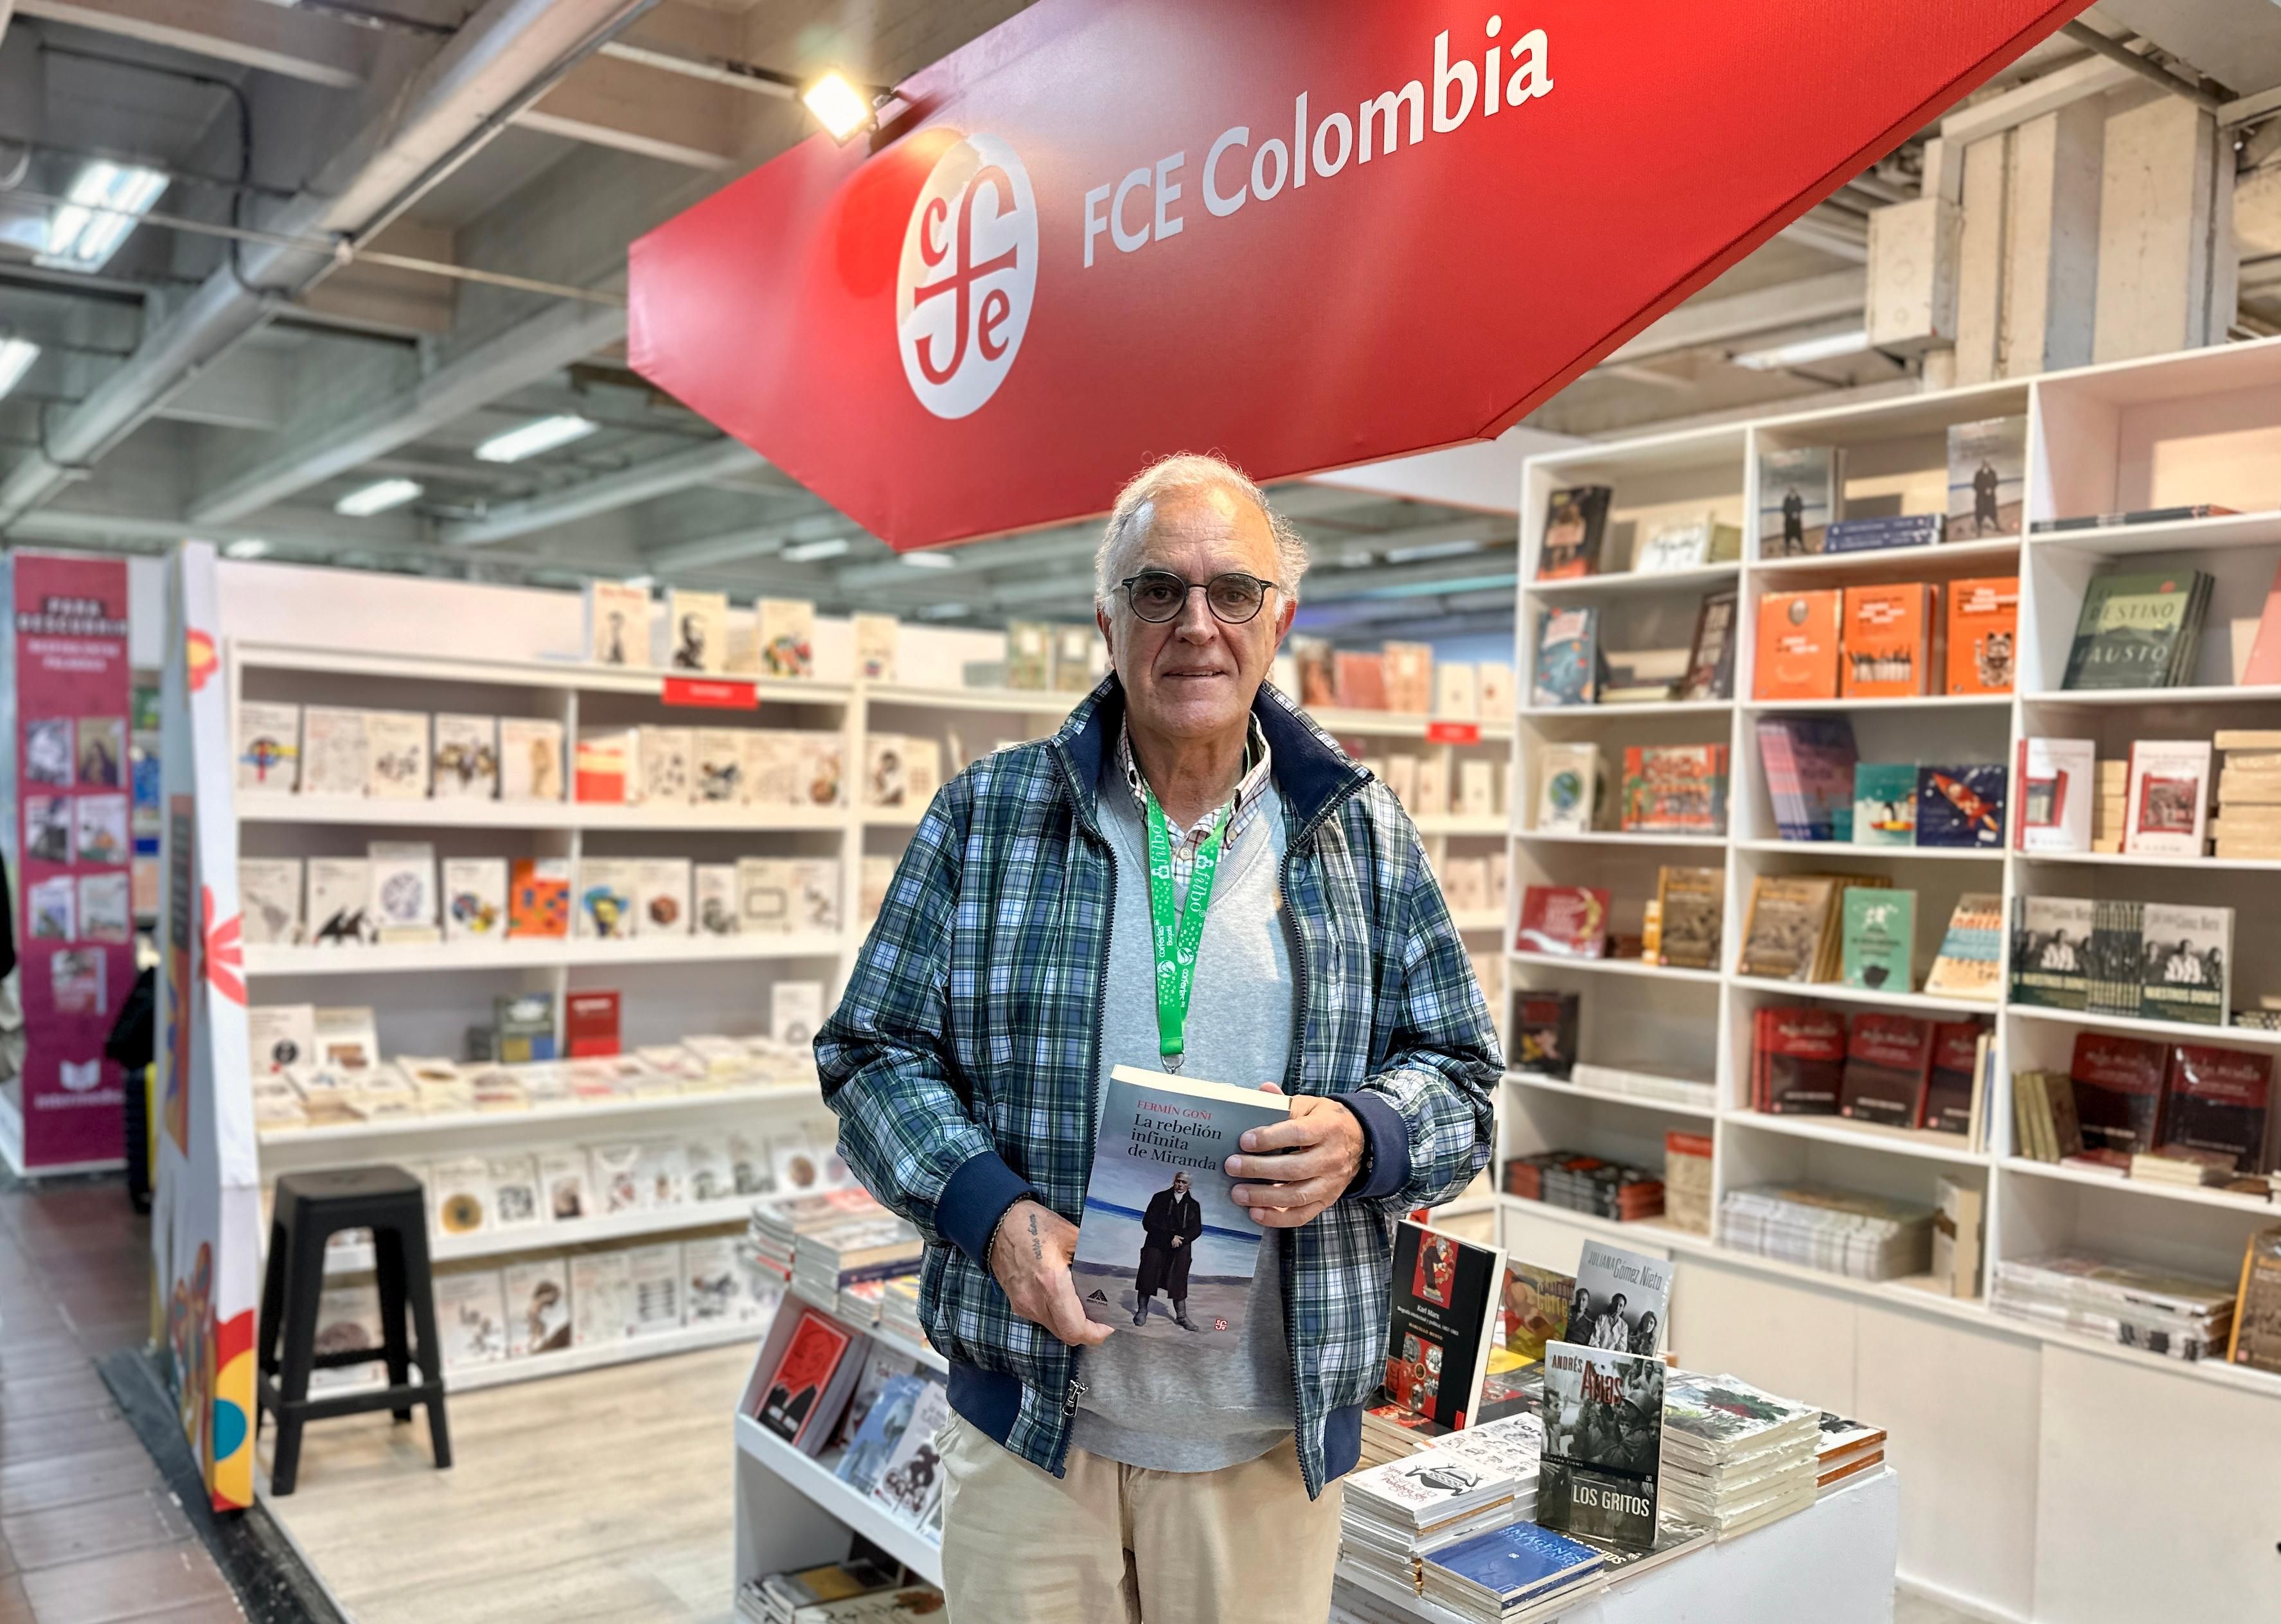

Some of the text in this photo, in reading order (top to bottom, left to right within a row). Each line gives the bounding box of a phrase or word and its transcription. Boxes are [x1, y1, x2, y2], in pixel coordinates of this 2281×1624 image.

[1083, 14, 1554, 268] FCE Colombia
[1151, 825, 1168, 864] filbo
[1190, 869, 1211, 912] filbo
[1137, 1100, 1212, 1120] FERMÍN GOÑI
[1131, 1128, 1189, 1151] infinita
[1134, 1113, 1221, 1140] La rebelión
[1128, 1143, 1217, 1170] de Miranda
[1588, 1251, 1662, 1291] JULIANA Gómez Nieto
[1417, 1305, 1440, 1320] Karl Marx
[1552, 1354, 1624, 1406] ANDRÉS Arias
[1573, 1485, 1650, 1517] LOS GRITOS
